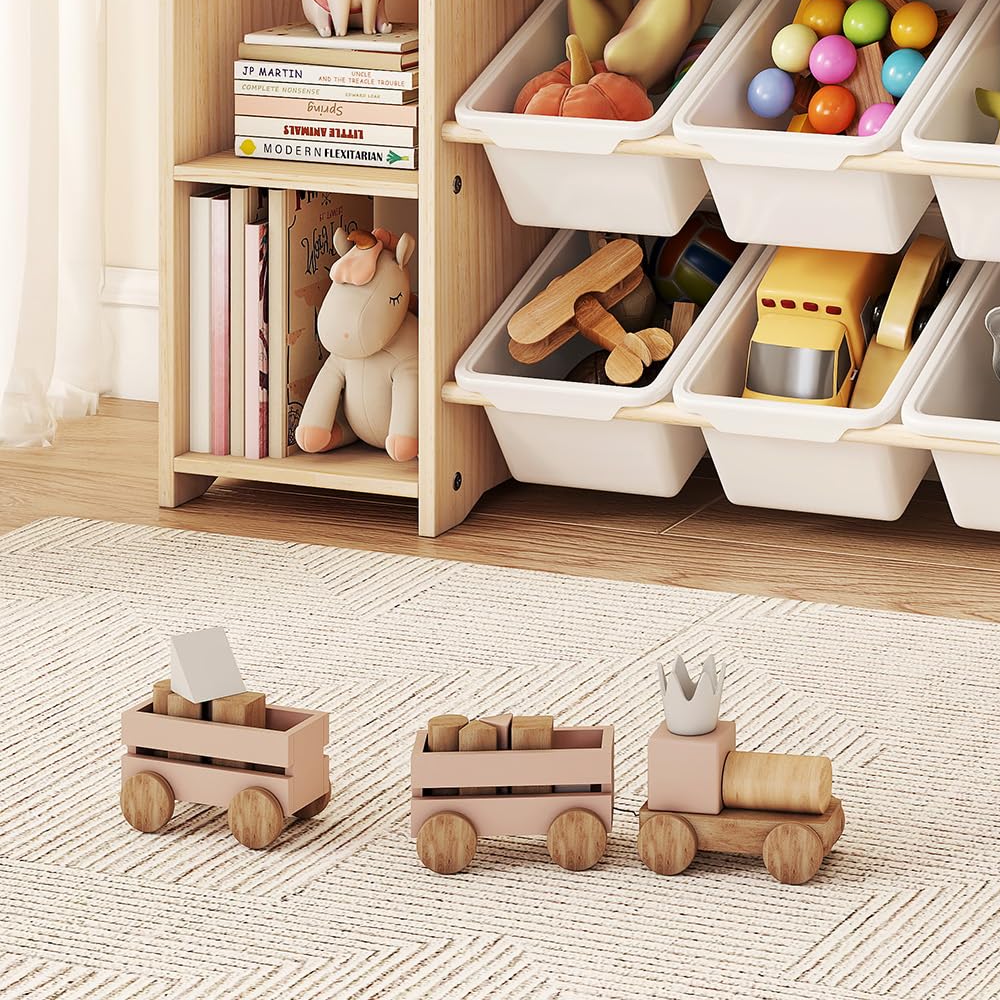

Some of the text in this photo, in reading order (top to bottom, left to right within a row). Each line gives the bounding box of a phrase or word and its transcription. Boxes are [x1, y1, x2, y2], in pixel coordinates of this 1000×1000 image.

[242, 66, 303, 79] JP MARTIN
[241, 83, 320, 95] COMPLETE NONSENSE
[348, 77, 375, 85] TREACLE
[377, 79, 405, 87] TROUBLE
[307, 101, 343, 116] Spring
[283, 124, 364, 140] LITTLE ANIMALS
[263, 143, 383, 162] MODERN FLEXITARIAN
